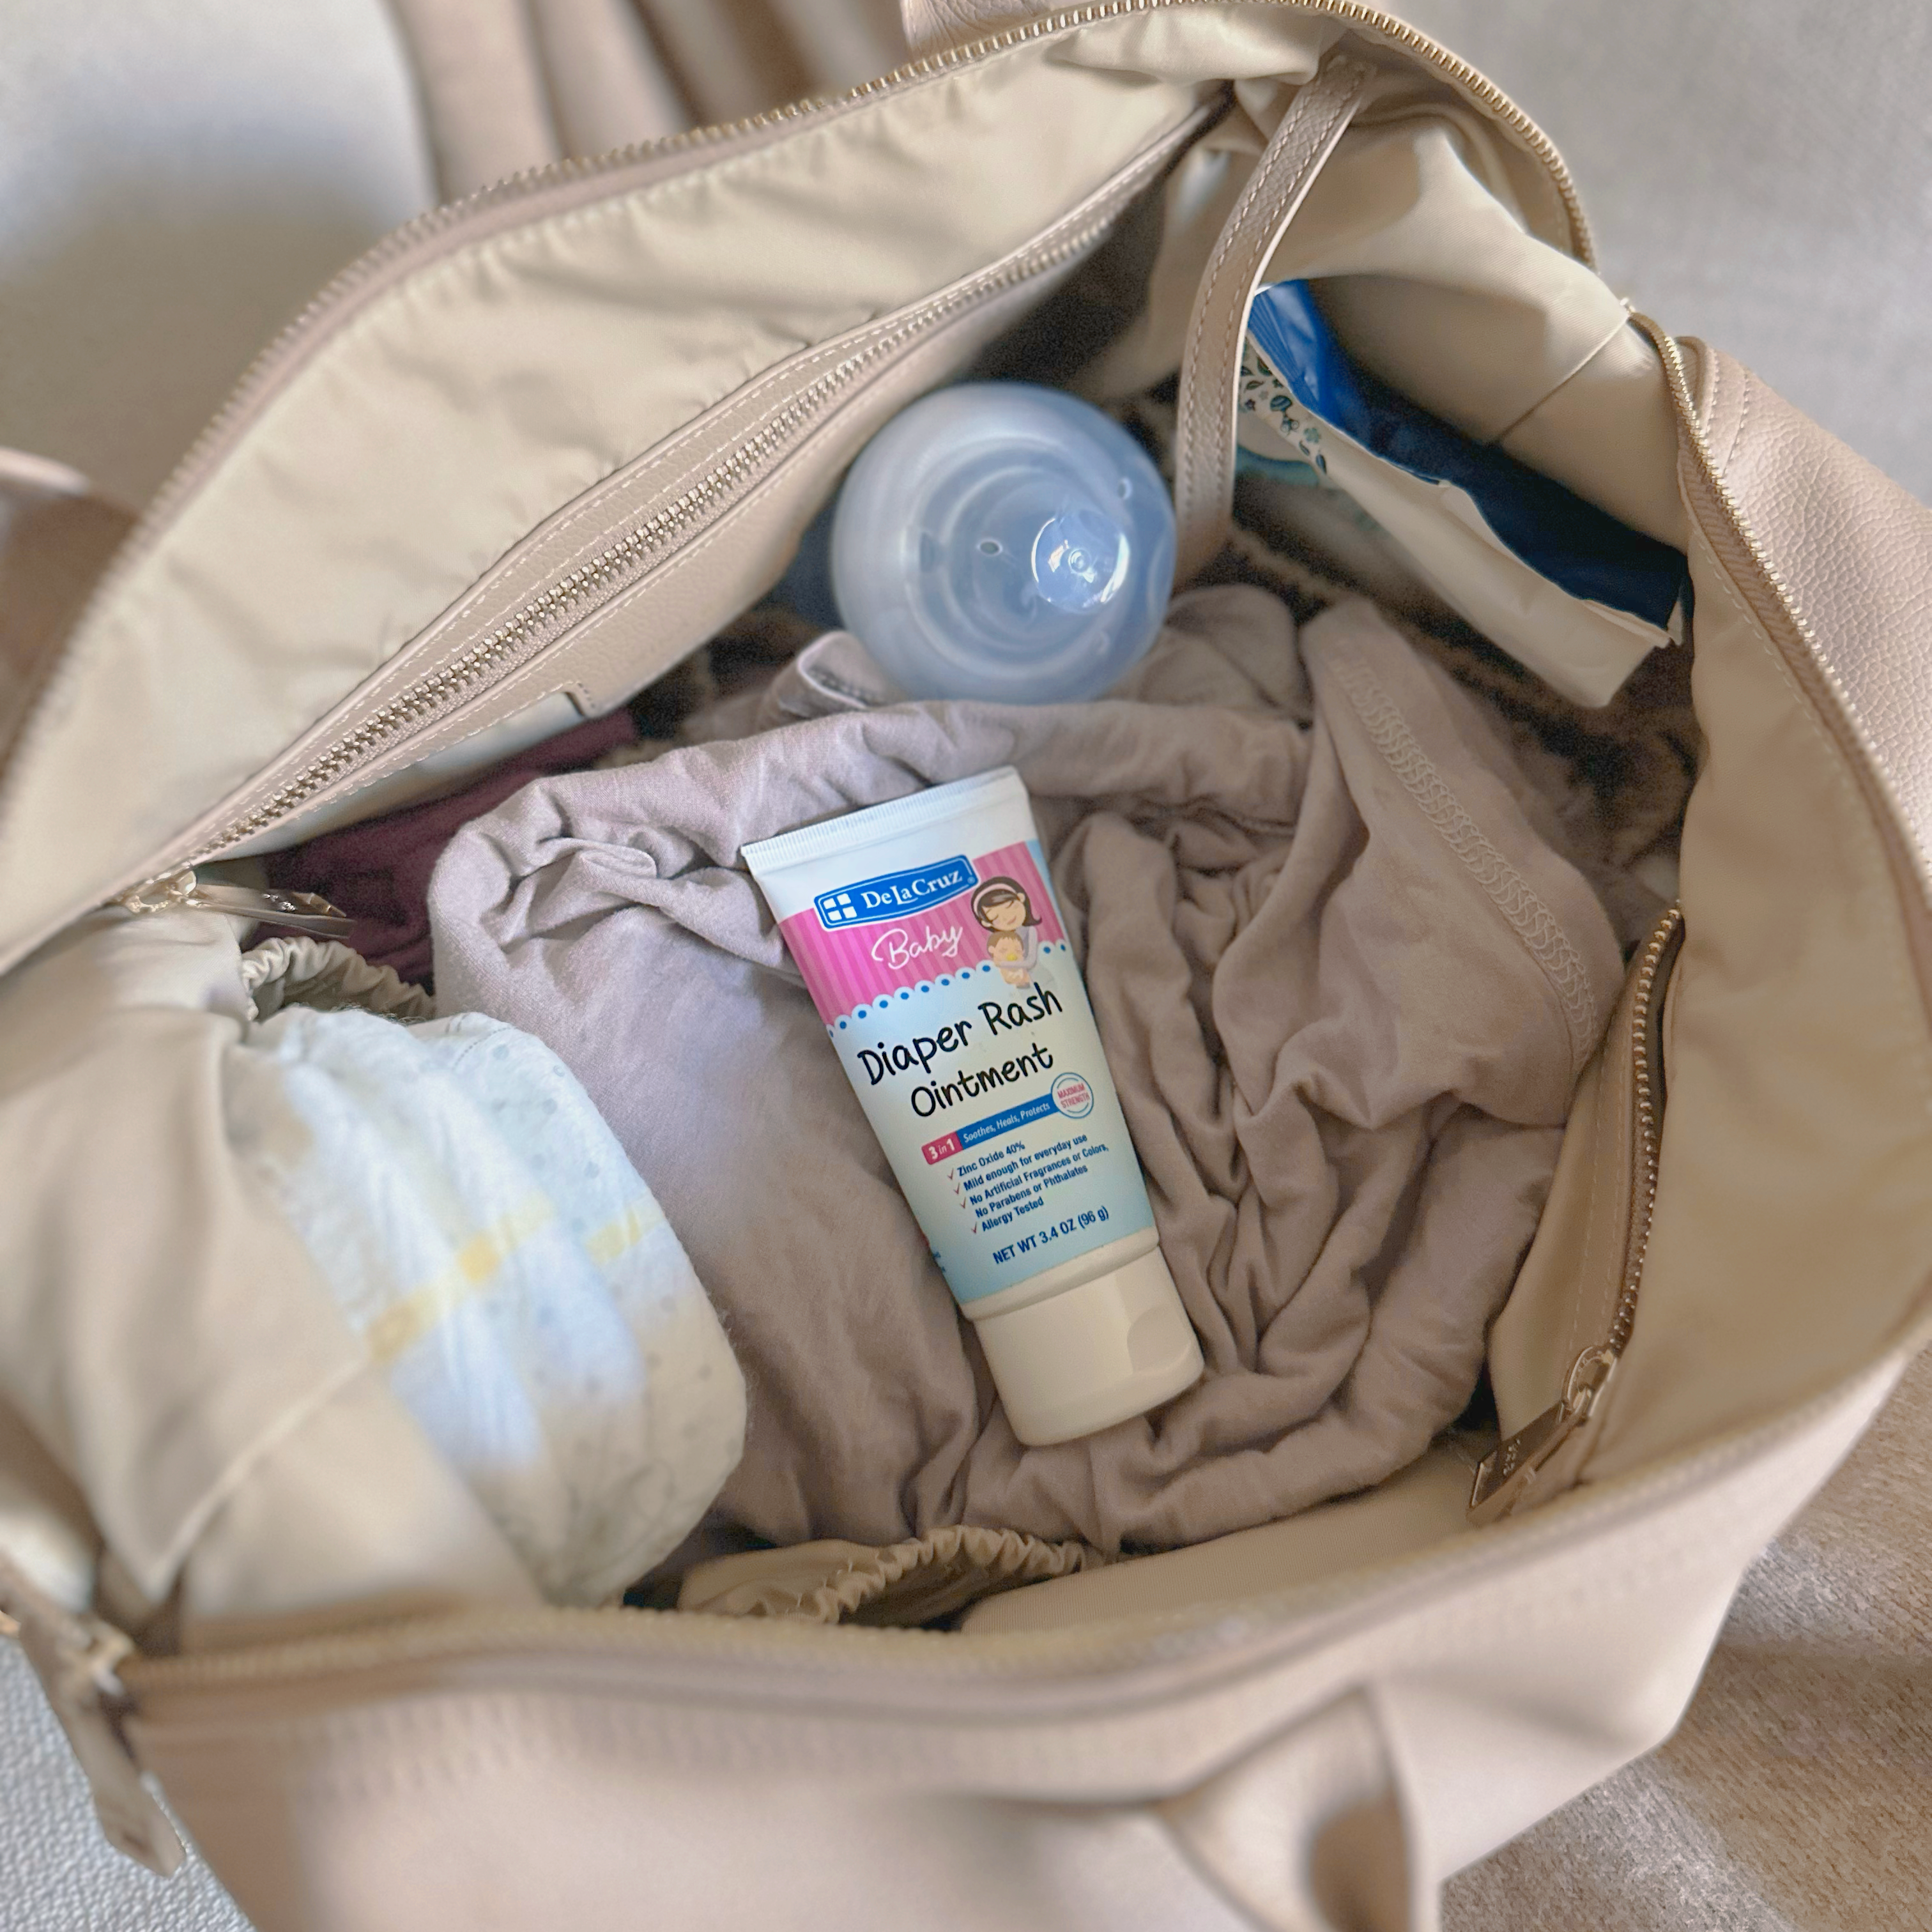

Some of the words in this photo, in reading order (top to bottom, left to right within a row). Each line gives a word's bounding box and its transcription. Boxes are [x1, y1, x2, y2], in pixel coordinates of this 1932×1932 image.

[871, 926, 963, 969] Baby
[857, 1021, 972, 1085] Diaper
[977, 982, 1062, 1035] Rash
[911, 1043, 1053, 1117] Ointment
[1057, 1083, 1085, 1099] MAXIMUM
[1061, 1092, 1090, 1108] STRENGTH
[963, 1124, 996, 1143] Soothes,
[996, 1114, 1020, 1130] Heals,
[1020, 1102, 1050, 1119] Protects
[928, 1146, 938, 1160] 3
[938, 1144, 946, 1155] in
[947, 1138, 955, 1151] 1
[957, 1163, 977, 1177] Zinc
[979, 1151, 1004, 1167] Oxide
[1006, 1140, 1025, 1155] 40%
[963, 1174, 985, 1191] Mild
[986, 1162, 1019, 1181] enough
[1020, 1154, 1032, 1165] for
[1034, 1139, 1071, 1160] everyday
[1073, 1134, 1087, 1145] use
[969, 1195, 983, 1206] No
[985, 1176, 1023, 1199] Artificial
[1023, 1157, 1071, 1181] Fragrances
[1073, 1152, 1081, 1162] or
[1082, 1143, 1109, 1158] Colors,
[975, 1207, 988, 1218] No
[989, 1187, 1031, 1212] Parabens
[1033, 1184, 1043, 1193] or
[1043, 1165, 1087, 1188] Phthalates
[981, 1211, 1013, 1232] Allergy
[1013, 1196, 1044, 1216] Tested
[993, 1245, 1015, 1264] NET
[1017, 1235, 1037, 1254] WT
[1039, 1226, 1059, 1243] 3.4
[1059, 1218, 1078, 1234] OZ
[1078, 1211, 1096, 1229] (96
[1097, 1205, 1109, 1222] g)
